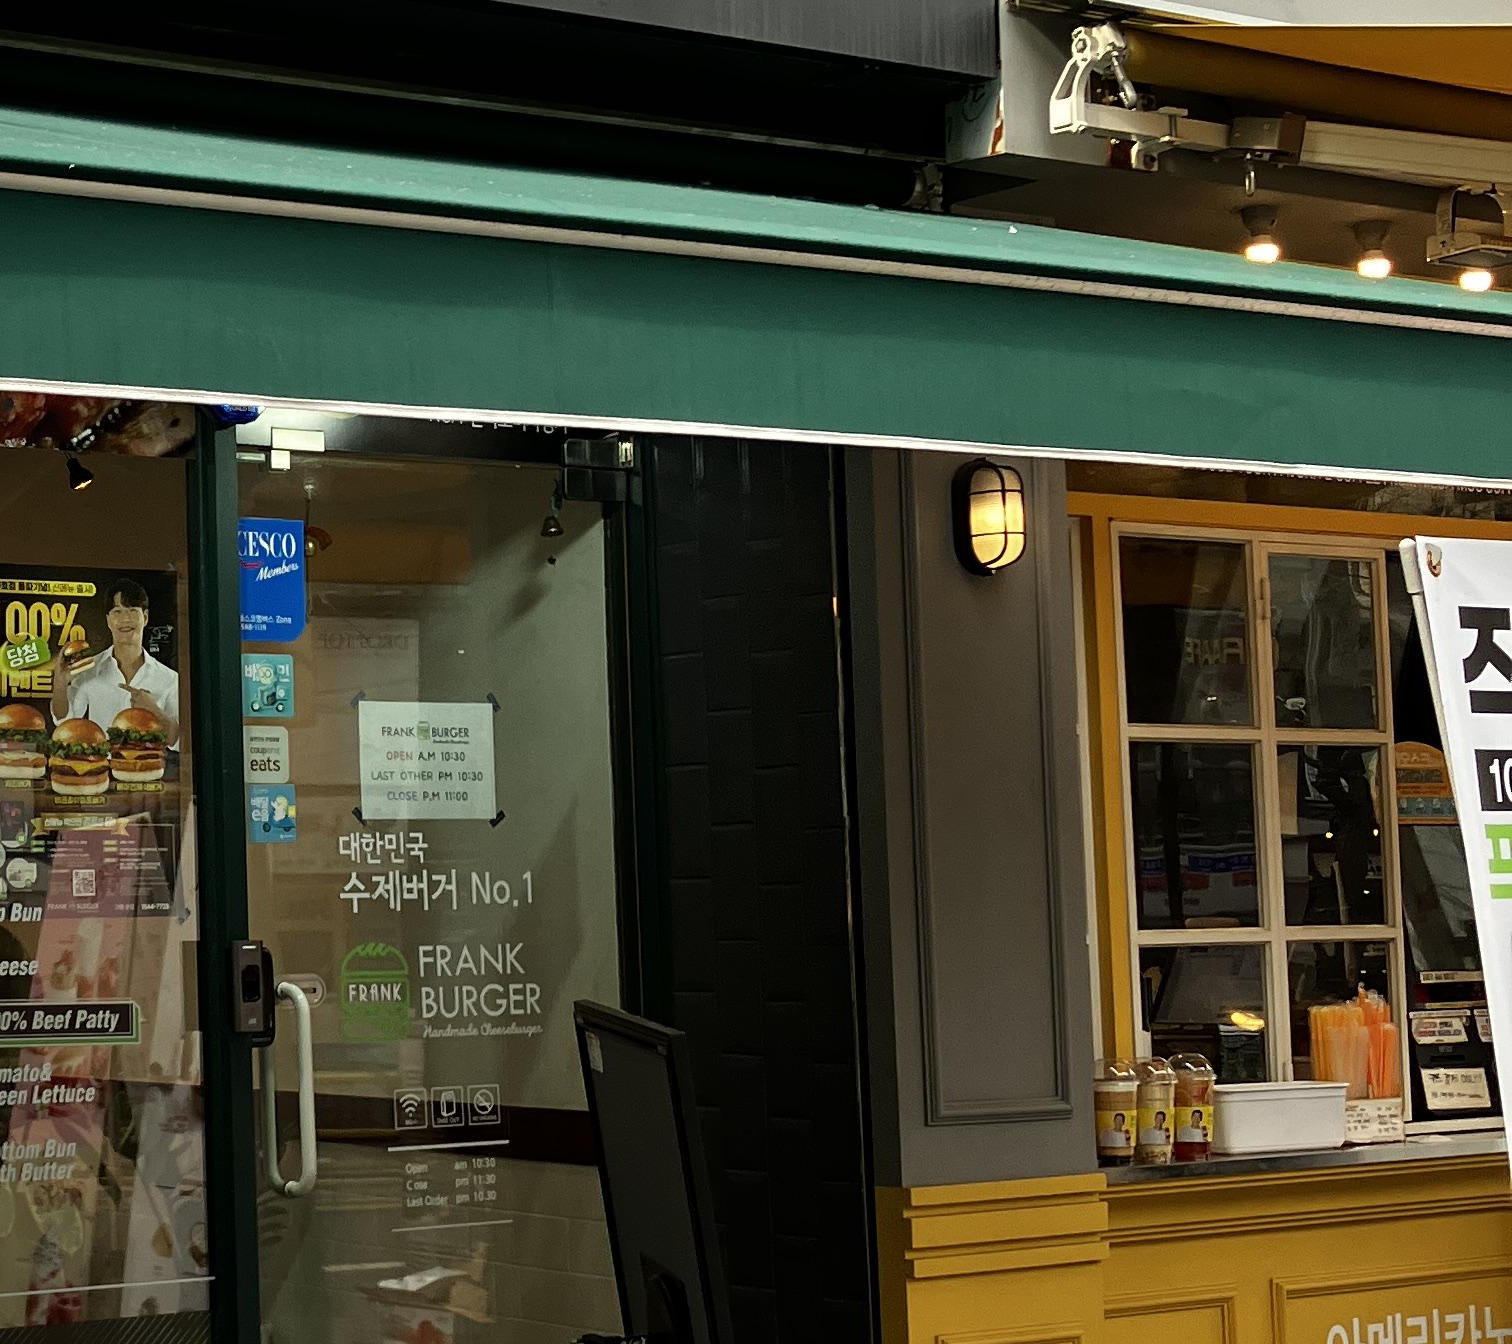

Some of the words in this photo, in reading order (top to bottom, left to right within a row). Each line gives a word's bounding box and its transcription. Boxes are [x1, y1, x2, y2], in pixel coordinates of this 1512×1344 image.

[381, 727, 415, 737] FRANK
[432, 727, 469, 738] BURGER
[250, 758, 280, 772] eats
[386, 751, 413, 760] OPEN
[418, 752, 436, 761] A.M
[441, 752, 465, 761] 10:30
[371, 771, 394, 780] LAST
[400, 771, 433, 781] OTHER
[439, 772, 452, 781] PM
[458, 772, 483, 781] 10:30
[387, 792, 417, 801] CLOSE
[423, 792, 440, 801] P.M
[445, 792, 468, 801] 11:00
[339, 832, 428, 864] 대한민국
[340, 869, 457, 913] 수제버거
[471, 871, 533, 907] No.1
[5, 905, 42, 922] Bun
[419, 943, 525, 978] FRANK
[349, 983, 402, 1002] FRANK
[421, 983, 541, 1018] BURGER
[32, 1011, 72, 1029] Beef
[76, 1011, 119, 1032] Patty
[32, 1084, 95, 1103] Lettuce
[45, 1139, 76, 1157] Bun
[21, 1162, 74, 1182] Butter
